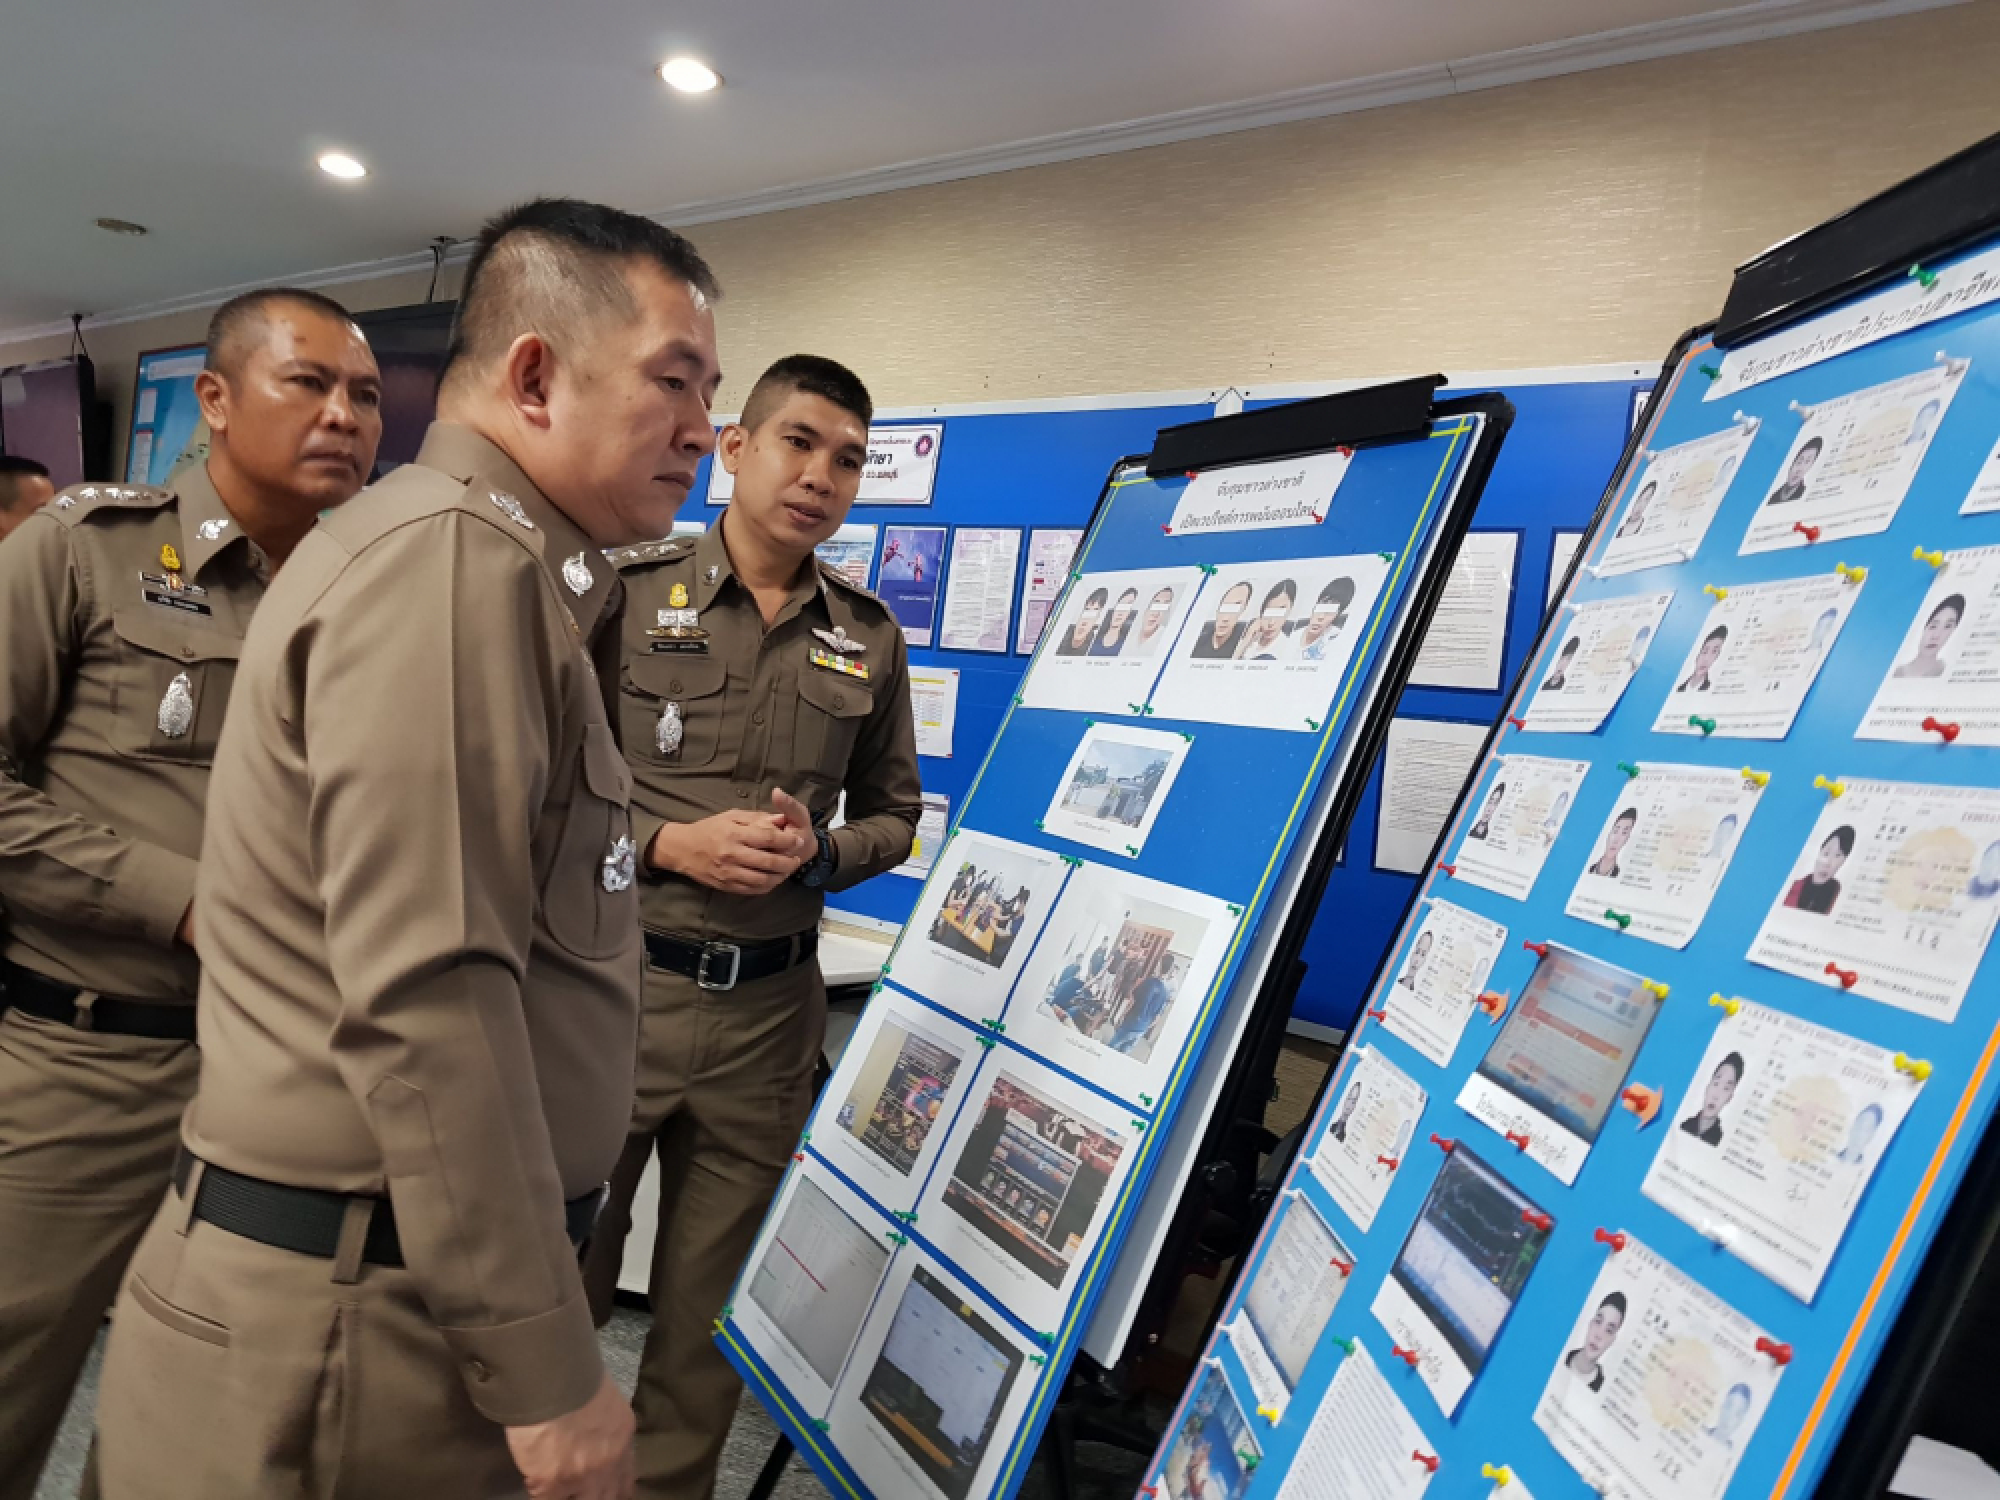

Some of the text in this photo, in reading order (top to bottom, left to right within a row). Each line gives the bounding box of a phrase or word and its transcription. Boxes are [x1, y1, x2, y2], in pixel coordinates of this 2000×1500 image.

[1217, 469, 1306, 500] จับกุมชาวต่างชาติ
